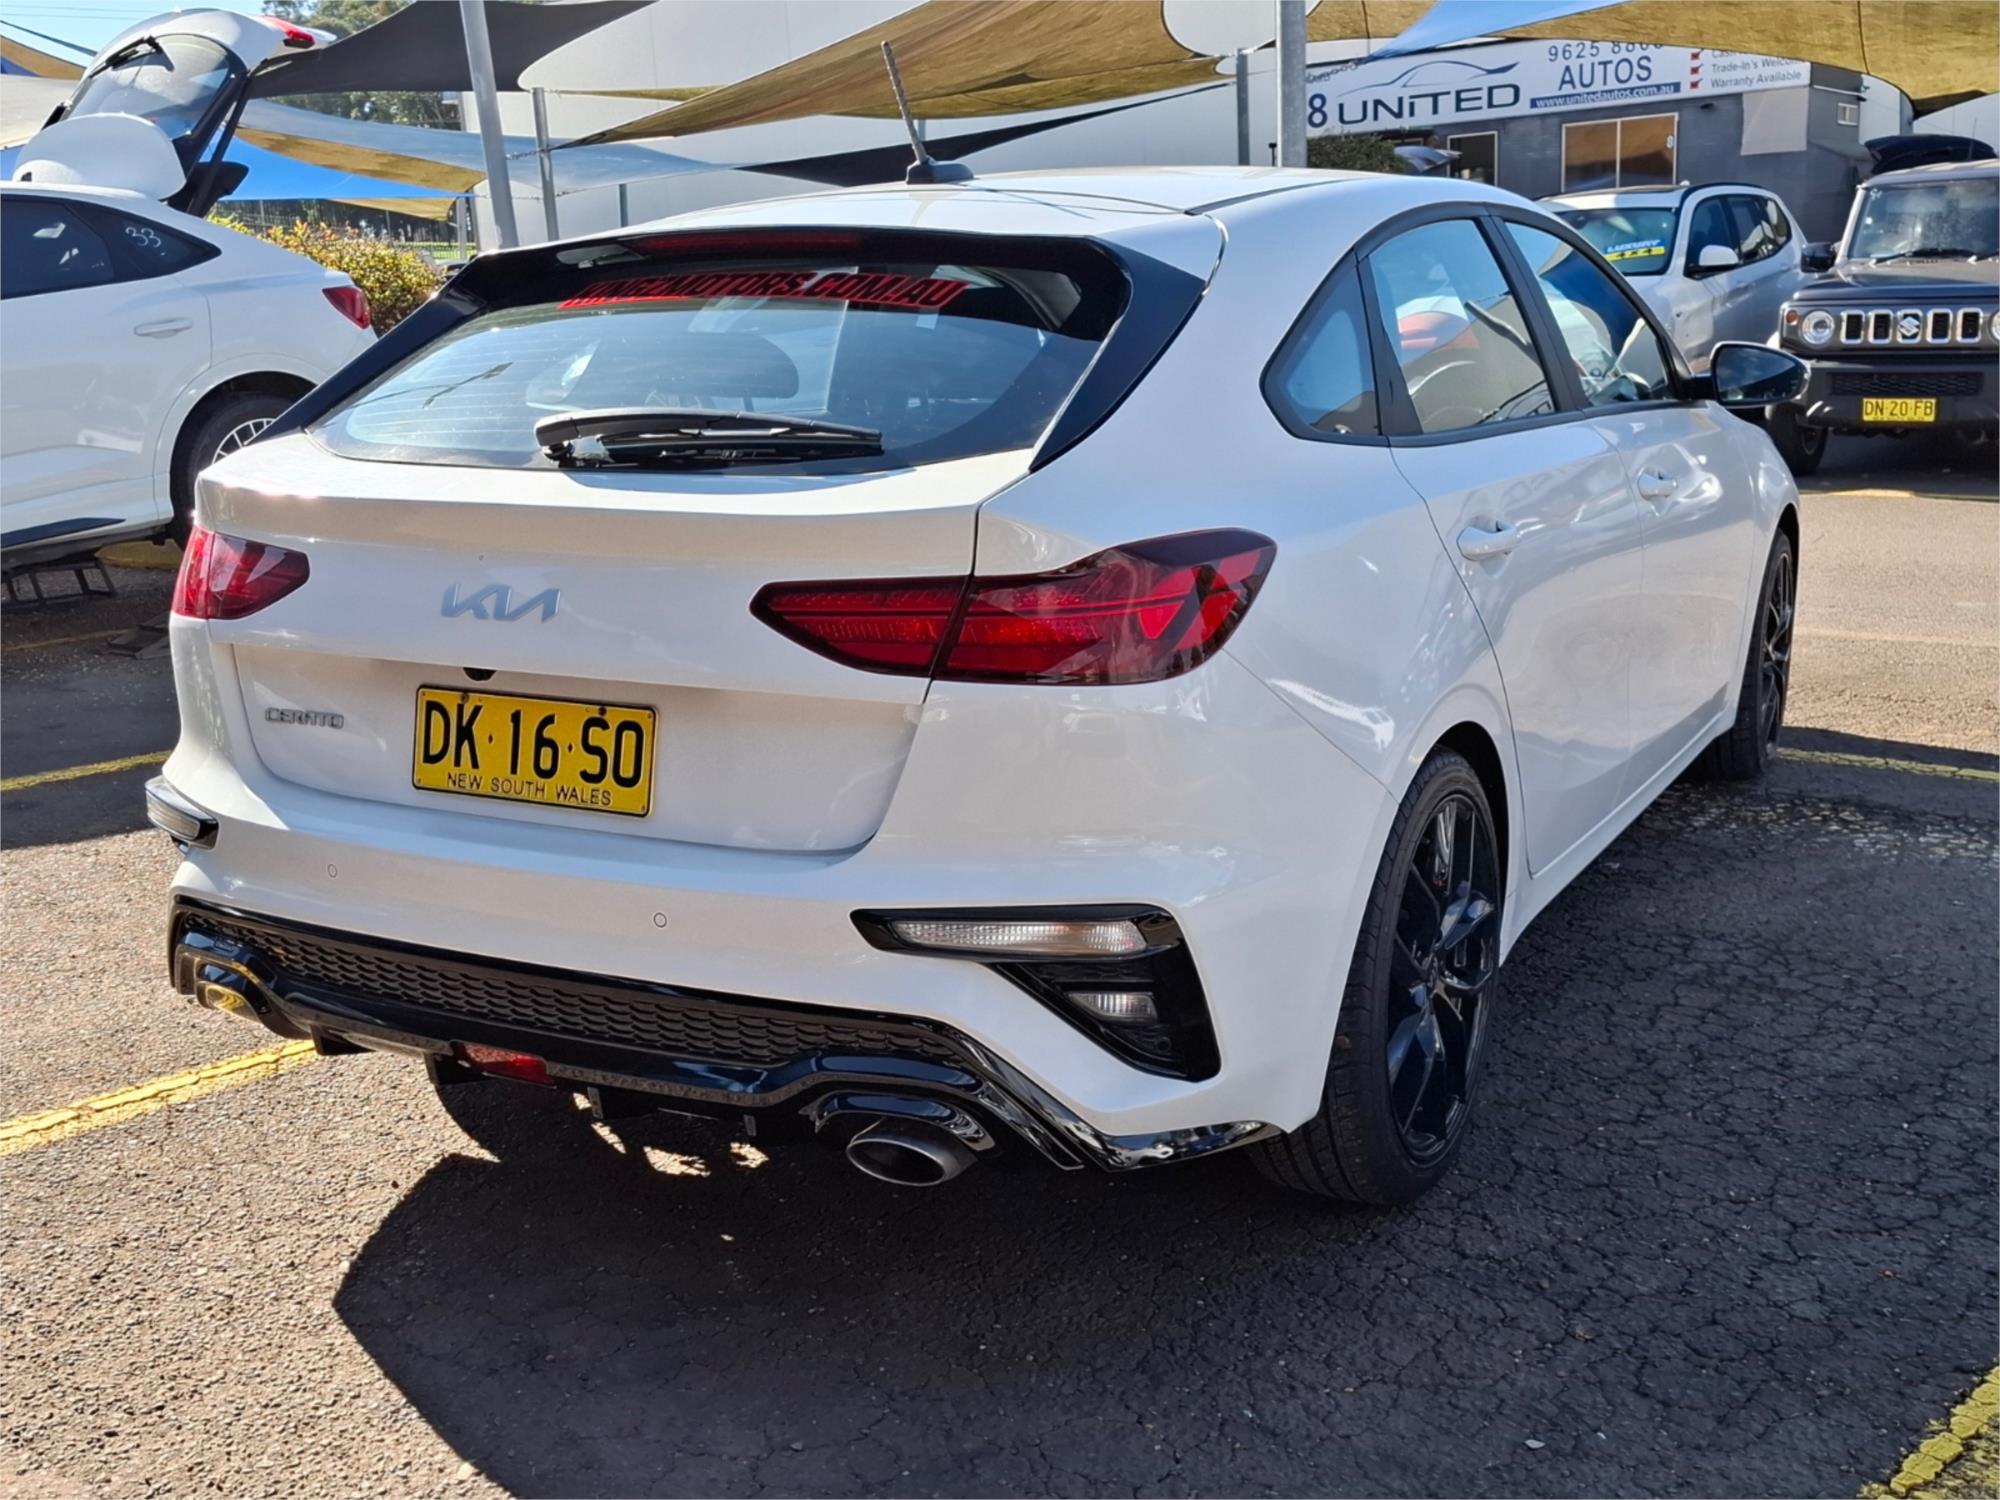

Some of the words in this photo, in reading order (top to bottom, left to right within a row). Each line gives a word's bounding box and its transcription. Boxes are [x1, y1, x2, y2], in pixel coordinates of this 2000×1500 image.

[1548, 40, 1600, 62] 9625
[1558, 55, 1652, 91] AUTOS
[1711, 77, 1753, 89] Warranty
[1757, 71, 1802, 83] Available
[1535, 84, 1674, 108] www.unitedautos.com.au
[125, 226, 162, 248] 33
[1607, 239, 1661, 253] LUXURY
[264, 707, 345, 729] CERATO
[447, 771, 483, 790] NEW
[491, 777, 546, 799] SOUTH
[556, 785, 612, 806] WALES
